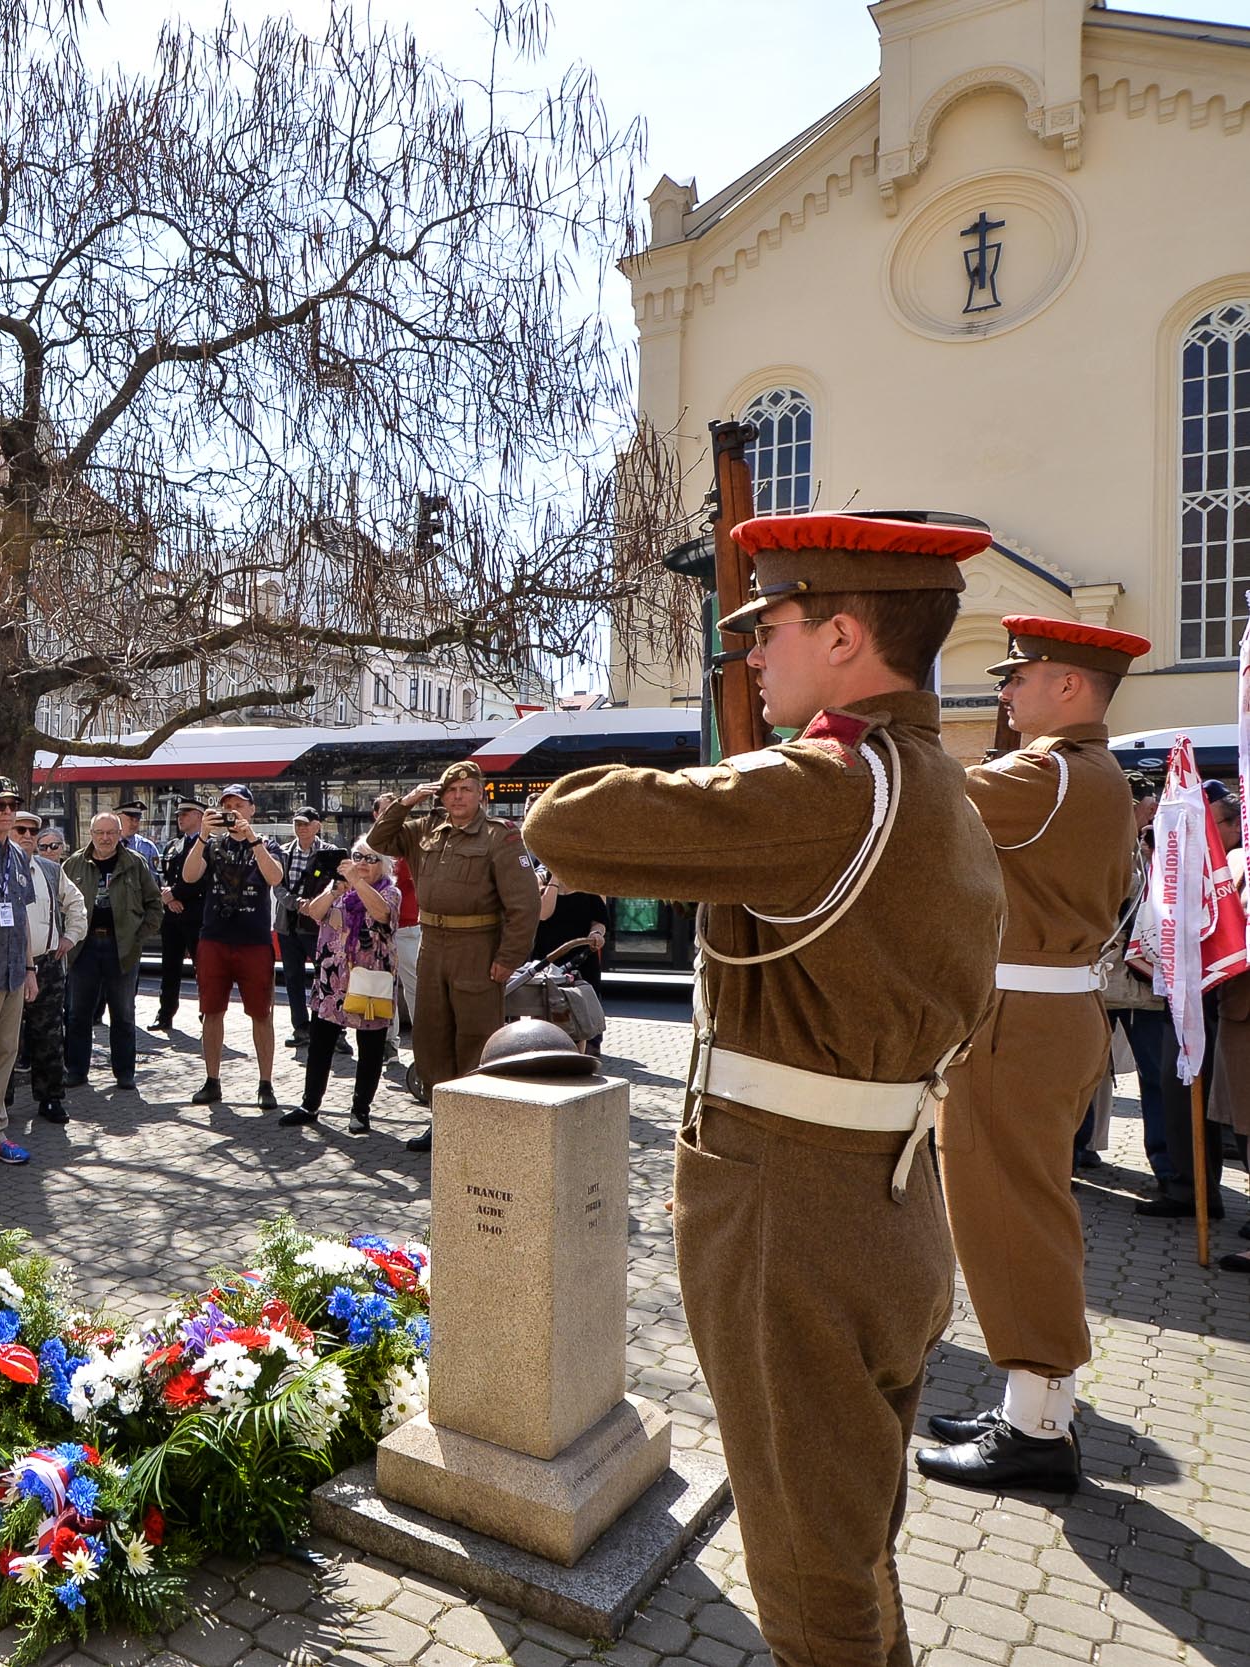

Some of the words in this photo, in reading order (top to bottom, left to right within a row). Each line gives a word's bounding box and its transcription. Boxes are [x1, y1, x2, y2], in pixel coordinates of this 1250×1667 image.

[467, 1185, 513, 1202] FRANCIE
[476, 1205, 504, 1218] AGDE
[478, 1223, 502, 1235] 1940
